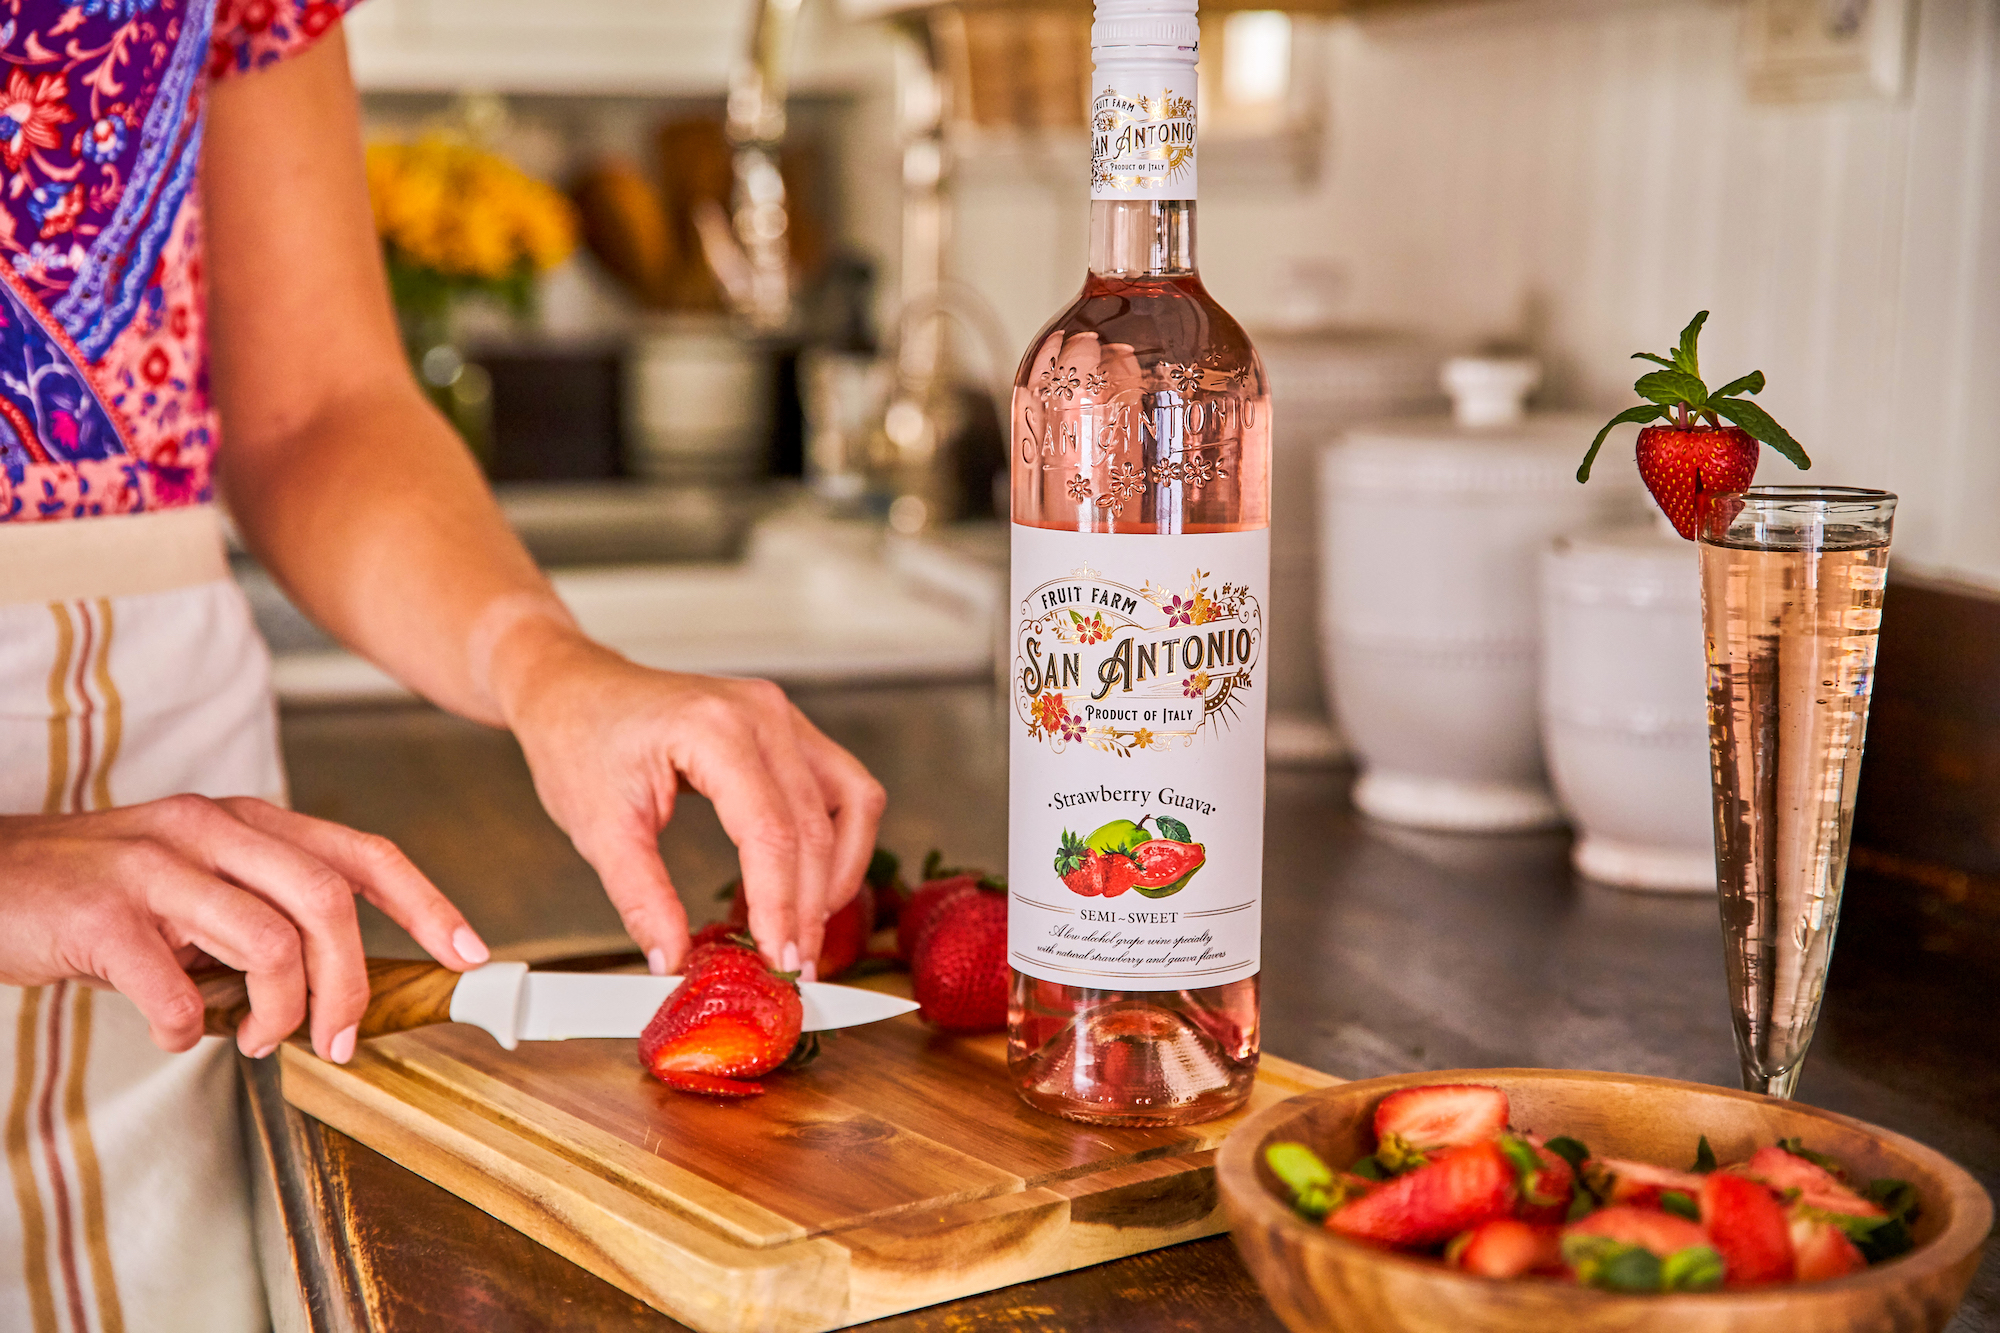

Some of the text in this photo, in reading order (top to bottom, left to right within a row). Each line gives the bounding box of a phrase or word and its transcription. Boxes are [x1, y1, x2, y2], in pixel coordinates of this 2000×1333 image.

[1112, 98, 1135, 113] FARM
[1091, 122, 1194, 160] AN ANTONIO
[1110, 162, 1136, 172] PRODUCT
[1148, 163, 1165, 172] ITALY
[1022, 398, 1256, 468] SAN ANTONIO
[1041, 586, 1138, 615] FRUIT FARM
[1023, 627, 1252, 702] SAN ANTONIO
[1085, 704, 1193, 724] PRODUCT OF ITALY
[1053, 785, 1211, 815] Strawberry Guava
[1048, 924, 1214, 950] A low alcohol grape wine specialty
[1037, 943, 1227, 969] with natural strawberry and guava flavors
